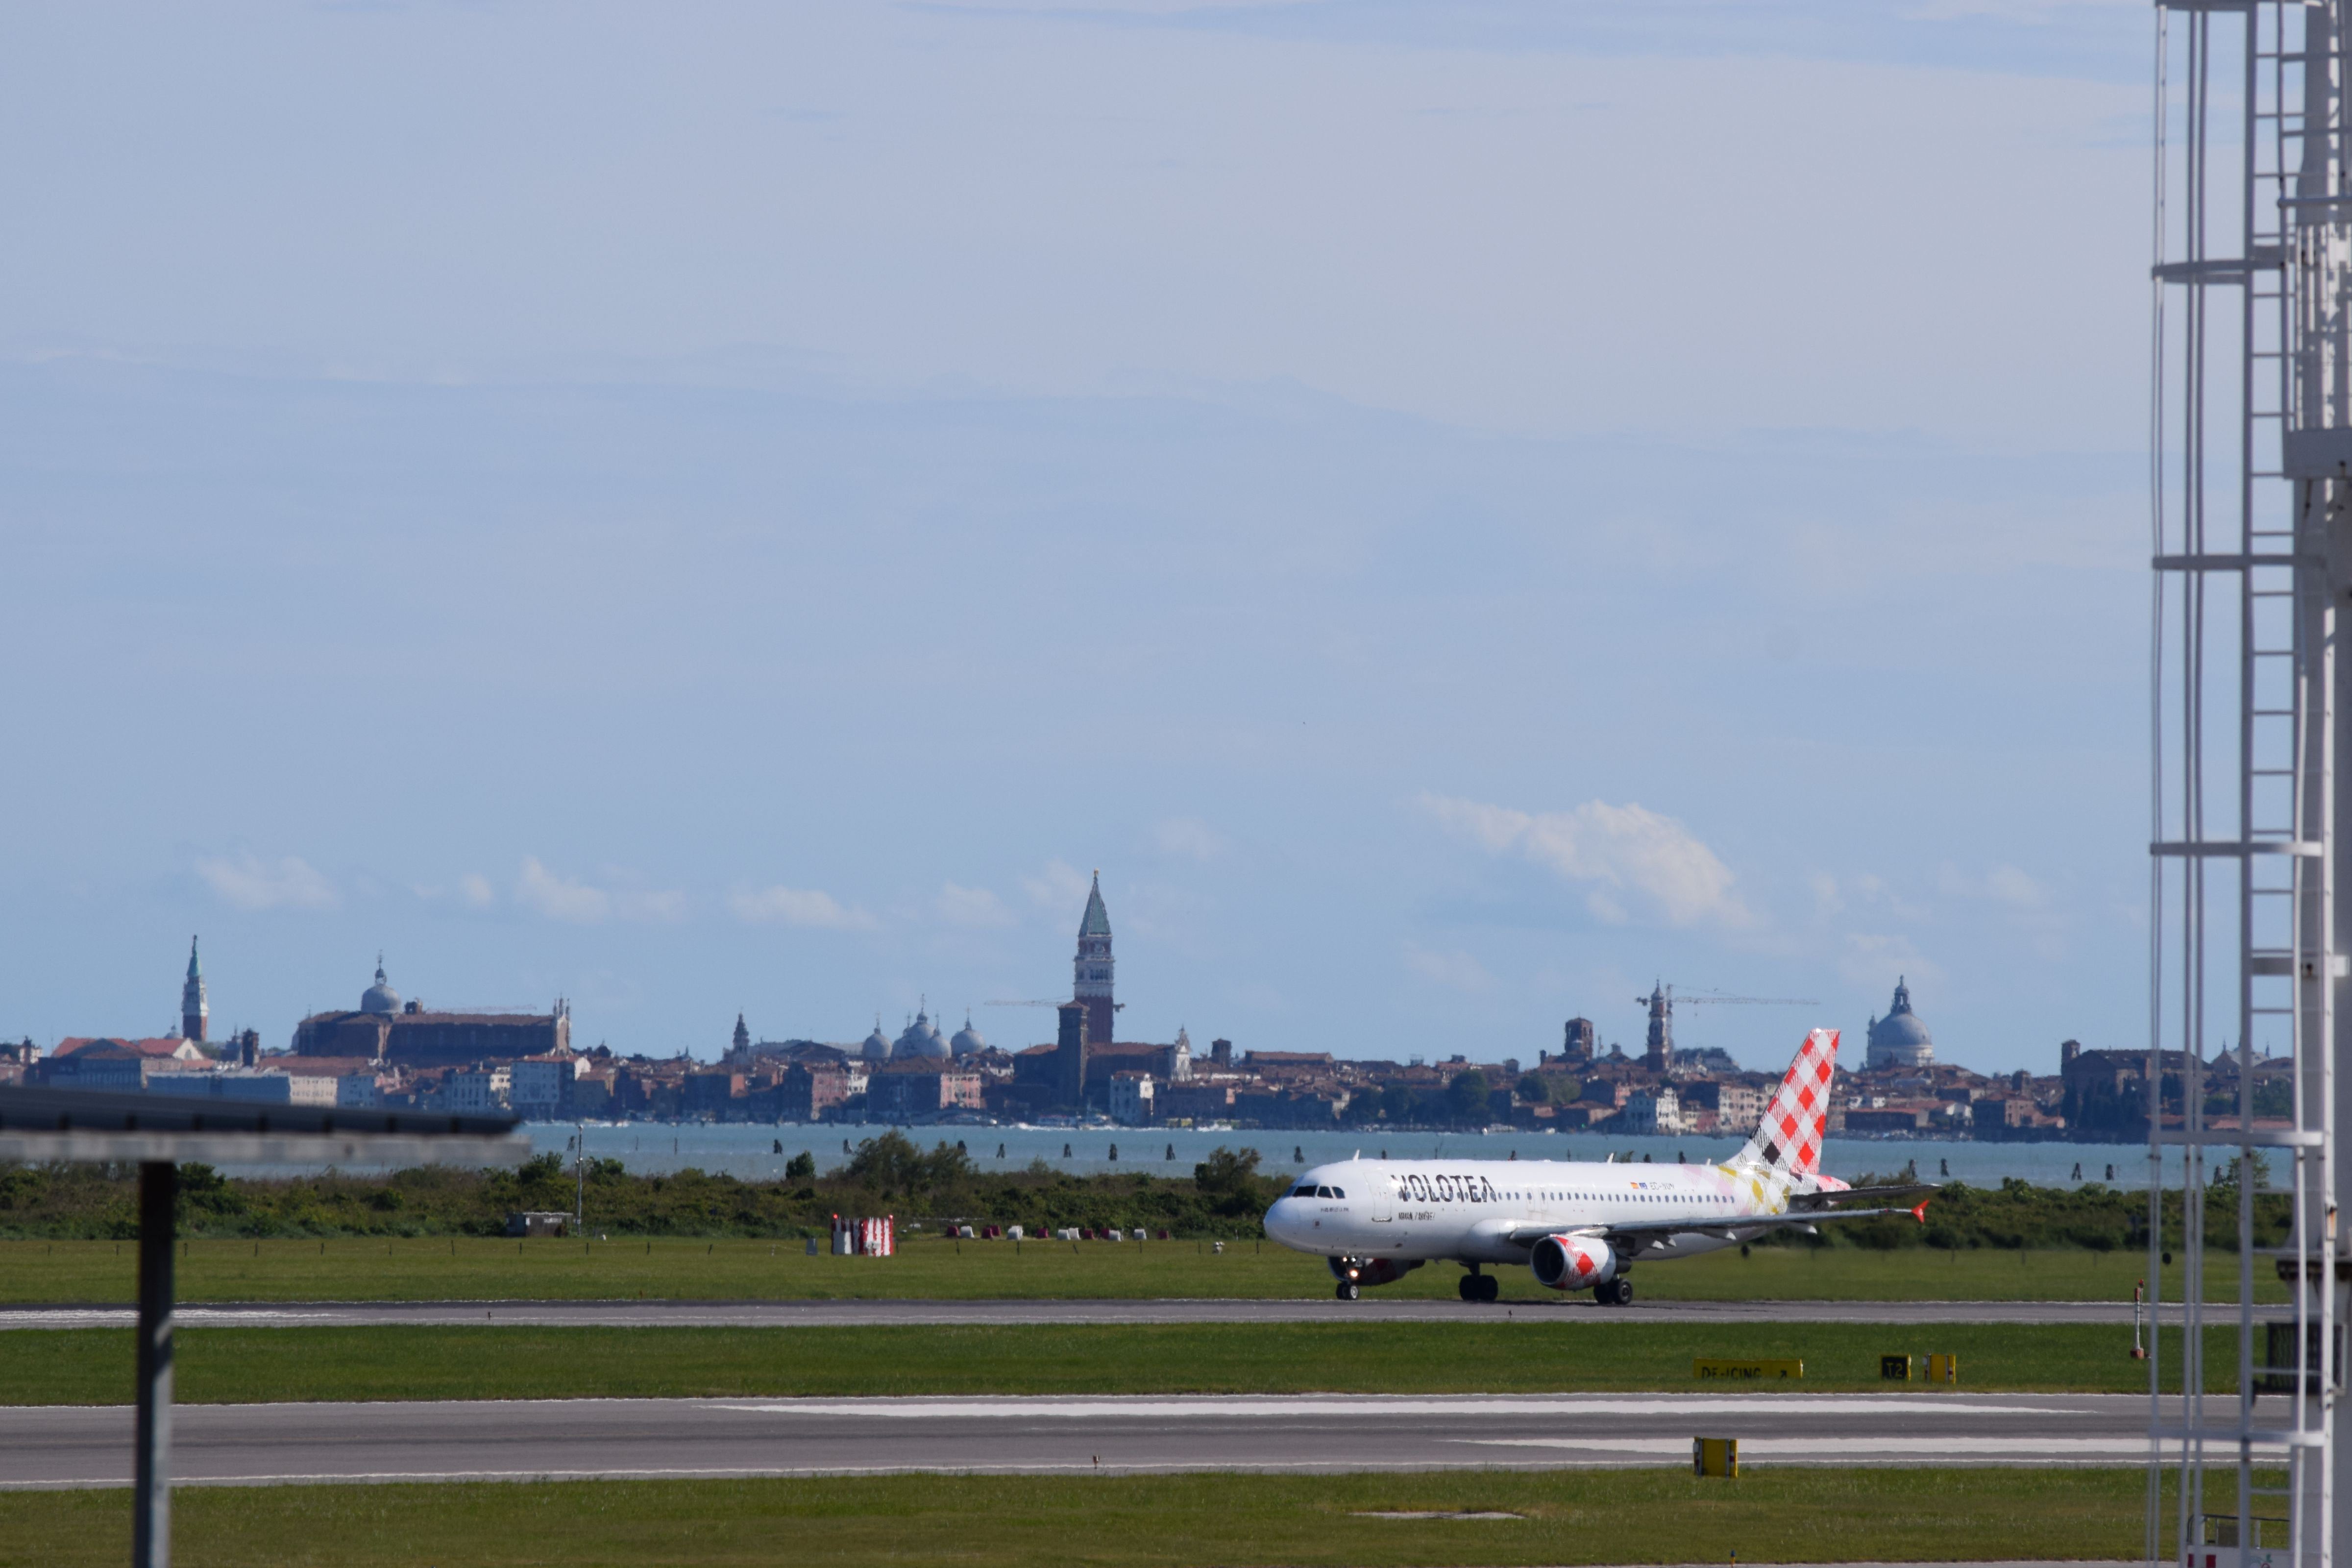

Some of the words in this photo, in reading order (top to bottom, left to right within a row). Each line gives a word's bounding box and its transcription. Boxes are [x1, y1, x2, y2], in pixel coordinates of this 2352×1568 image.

[1390, 1175, 1497, 1202] VOLOTEA
[1701, 1367, 1762, 1380] DE-ICING
[1886, 1362, 1903, 1377] T2
